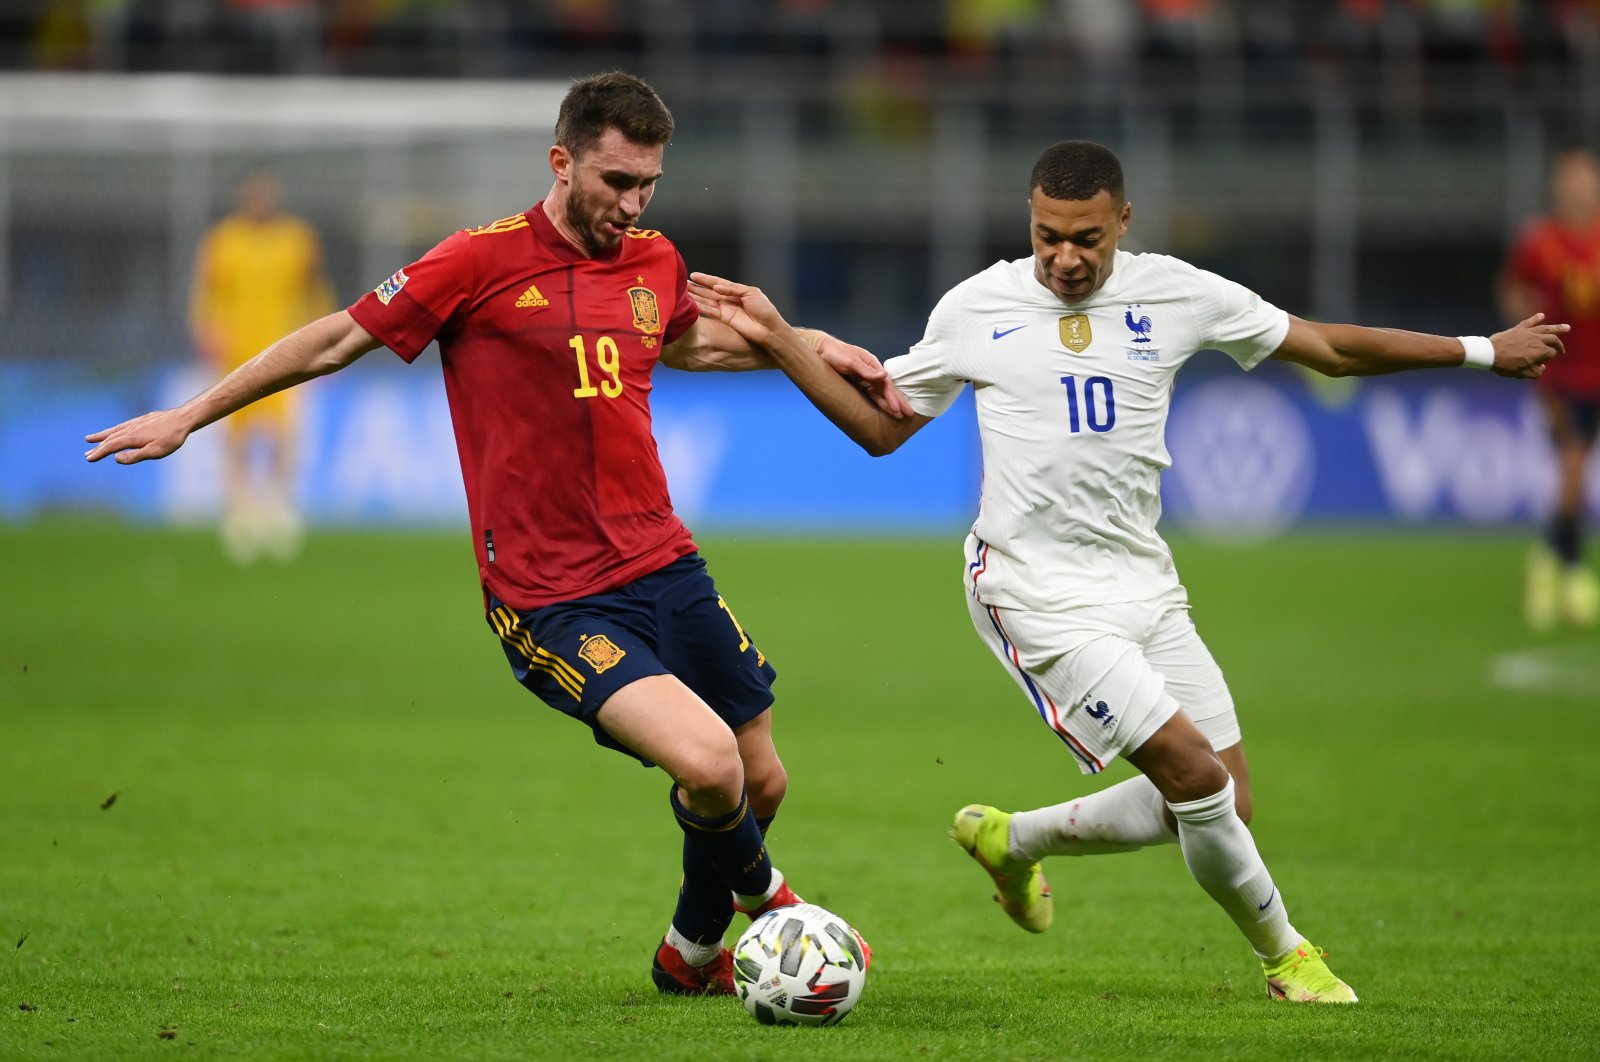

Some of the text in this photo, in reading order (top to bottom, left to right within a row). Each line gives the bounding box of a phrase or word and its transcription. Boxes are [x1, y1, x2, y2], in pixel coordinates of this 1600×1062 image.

[515, 298, 549, 308] adidas
[569, 335, 624, 399] 19
[1060, 375, 1116, 433] 10
